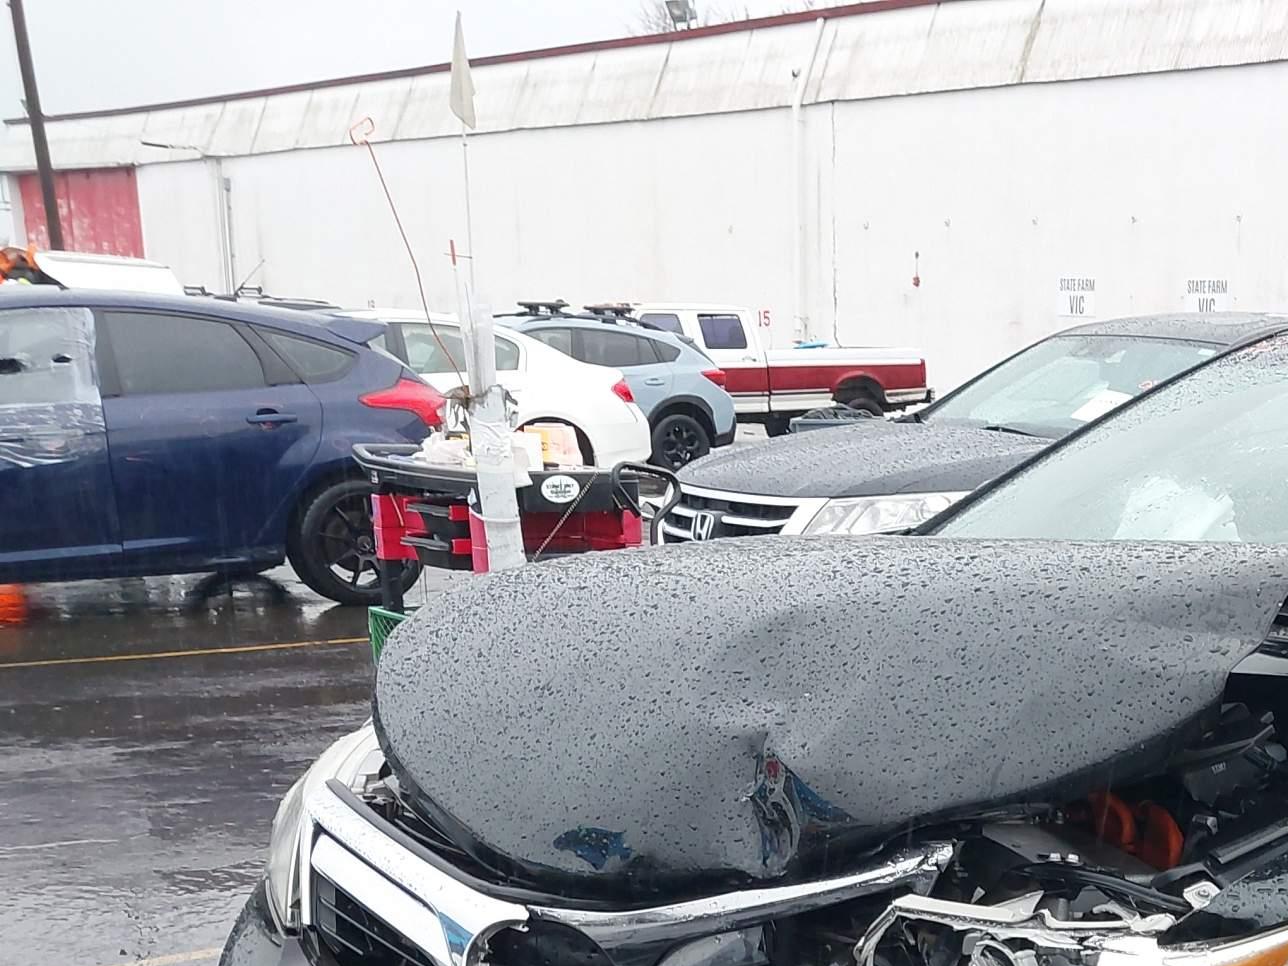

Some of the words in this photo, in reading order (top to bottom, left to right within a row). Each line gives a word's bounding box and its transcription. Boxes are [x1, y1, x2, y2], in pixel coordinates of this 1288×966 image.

[1059, 278, 1076, 292] STATE
[1077, 278, 1096, 292] FARM
[1187, 279, 1206, 295] STATE
[1207, 279, 1228, 295] FARM
[1069, 295, 1086, 315] VIC
[758, 310, 771, 327] 15
